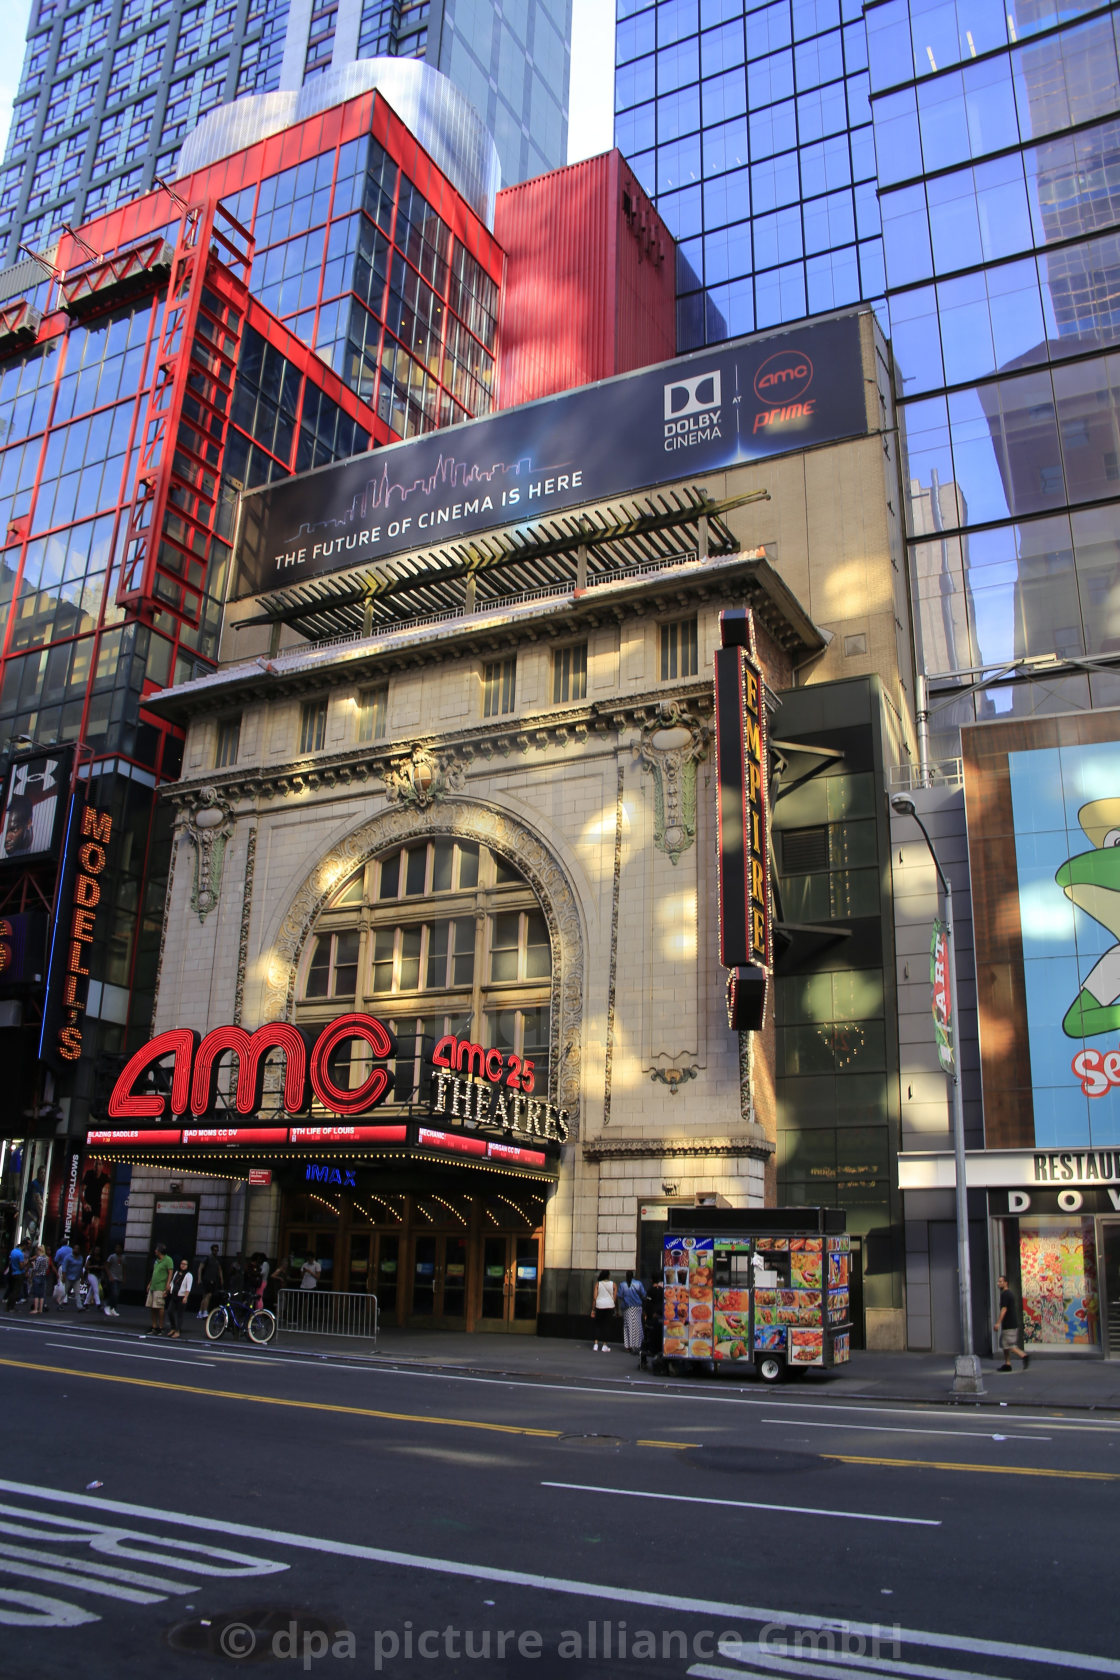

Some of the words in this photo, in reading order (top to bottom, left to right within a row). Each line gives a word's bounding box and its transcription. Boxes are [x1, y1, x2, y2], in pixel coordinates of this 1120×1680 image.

[732, 395, 742, 404] AT
[664, 410, 721, 437] DOLBY
[664, 426, 722, 451] CINEMA
[275, 547, 306, 570] THE
[312, 528, 380, 559] FUTURE
[387, 518, 412, 537] OF
[418, 496, 493, 528] CINEMA
[502, 488, 520, 506] IS
[528, 471, 583, 499] HERE
[745, 669, 766, 954] EMPIRE
[59, 805, 113, 1061] MODELL'S
[506, 1055, 535, 1092] 25
[432, 1071, 570, 1144] THEATRES
[112, 1130, 138, 1138] SADDLES
[292, 1128, 305, 1136] 9TH
[333, 1127, 354, 1135] LOUIS
[68, 1154, 79, 1200] FOLLOWS
[306, 1163, 356, 1187] IMAX
[64, 1201, 74, 1233] NEVER
